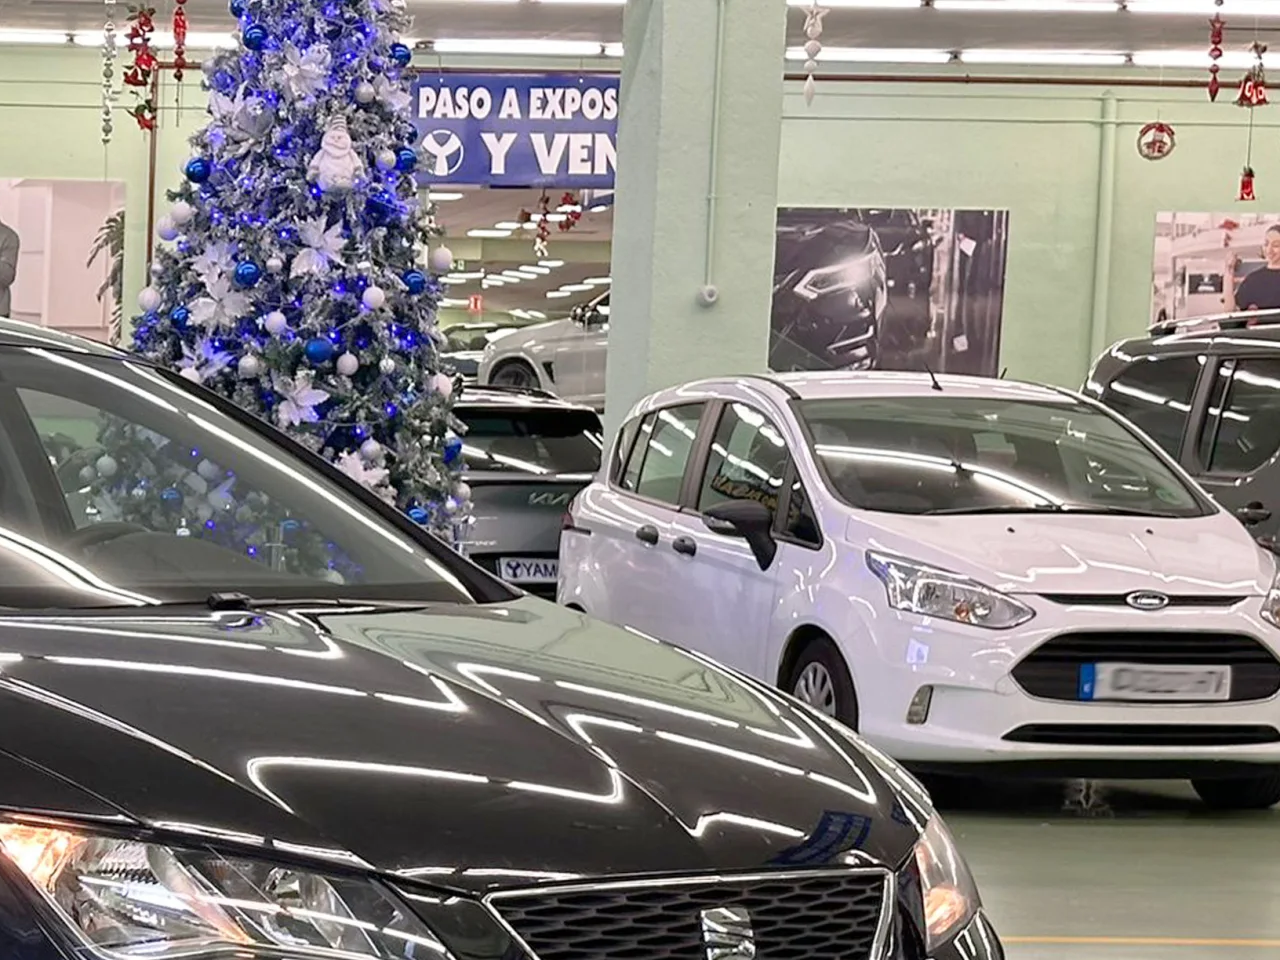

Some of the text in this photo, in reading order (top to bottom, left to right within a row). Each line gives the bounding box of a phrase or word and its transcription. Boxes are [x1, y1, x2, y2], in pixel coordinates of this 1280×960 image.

[418, 87, 618, 120] PASO A EXPOS
[480, 133, 518, 175] Y
